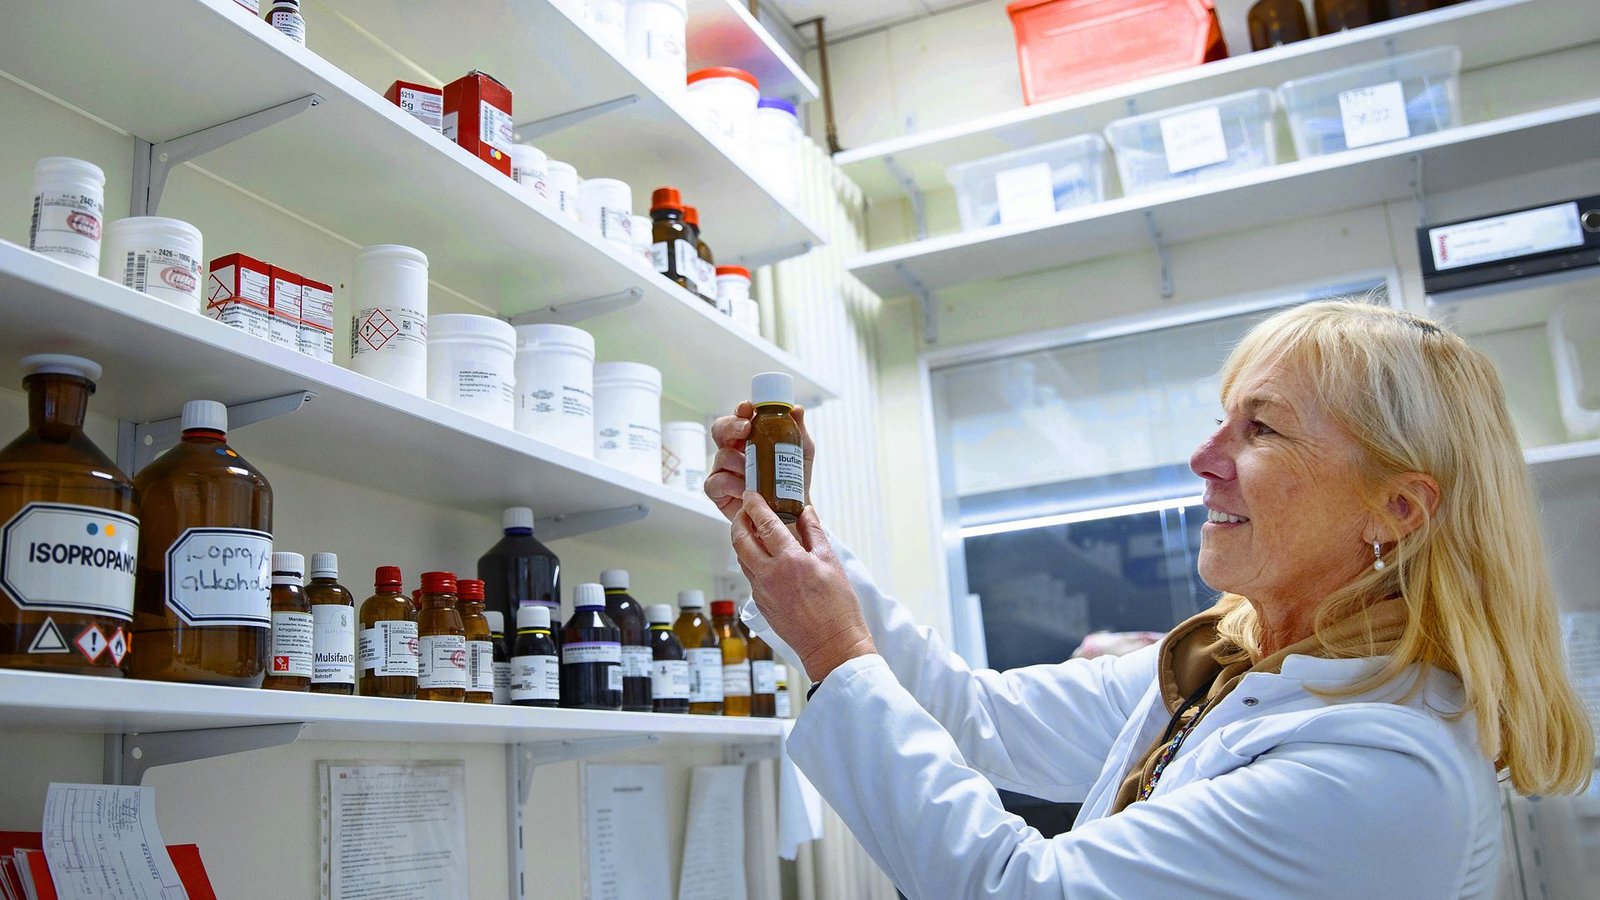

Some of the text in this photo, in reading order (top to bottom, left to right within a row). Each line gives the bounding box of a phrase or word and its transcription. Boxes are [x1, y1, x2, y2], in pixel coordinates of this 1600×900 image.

[401, 100, 413, 110] 5g
[29, 542, 136, 577] ISOPROPANO
[314, 652, 347, 663] Mulsifan
